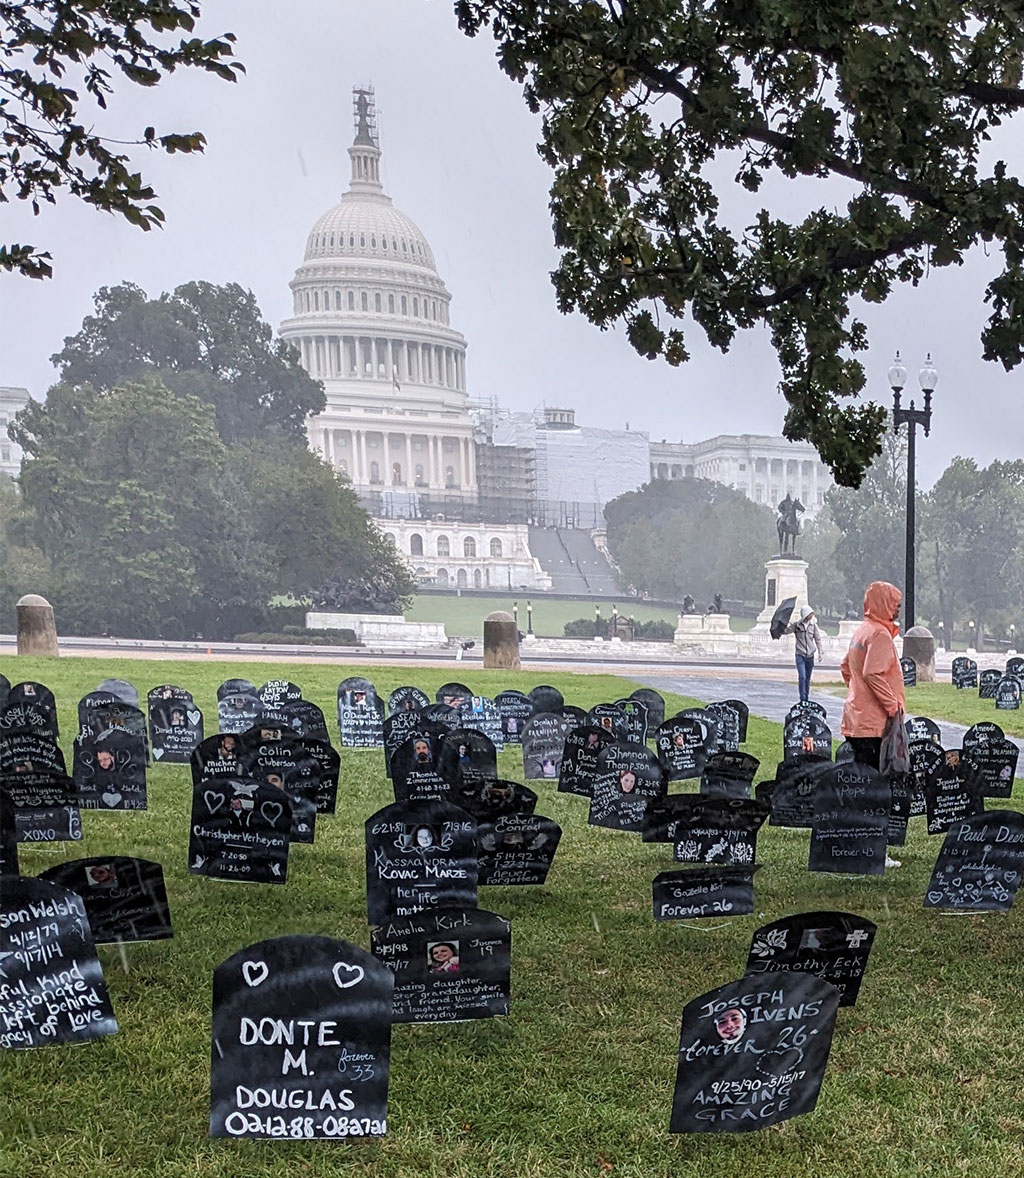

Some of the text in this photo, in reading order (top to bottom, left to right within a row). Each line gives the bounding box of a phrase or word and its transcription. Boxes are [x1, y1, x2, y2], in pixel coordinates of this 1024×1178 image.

[391, 720, 421, 729] BLAK
[259, 746, 292, 756] Colin
[605, 760, 650, 771] Thompson
[835, 769, 872, 784] Robert
[494, 822, 541, 833] Conrad
[497, 815, 536, 825] Robert
[193, 825, 285, 848] Christopher Verheyen
[957, 824, 989, 842] Paul
[831, 846, 860, 857] Forever
[378, 866, 468, 880] KOVAC MARZE
[397, 886, 439, 904] her life
[29, 894, 86, 919] Welsh
[661, 898, 733, 917] Forever 26
[9, 922, 60, 949] 4/12/79
[386, 912, 474, 939] Amelia Kirk
[14, 942, 64, 972] 9/17/14
[480, 947, 494, 957] 19
[751, 959, 829, 976] Timothy
[46, 987, 104, 1017] behind
[698, 988, 785, 1019] JOSEPH
[750, 999, 823, 1024] IVENS
[40, 1015, 59, 1037] of
[67, 1008, 105, 1033] Love
[239, 1017, 341, 1047] DONTE
[281, 1048, 315, 1076] M.
[236, 1085, 356, 1111] DOUGLAS
[694, 1097, 791, 1123] GRACE
